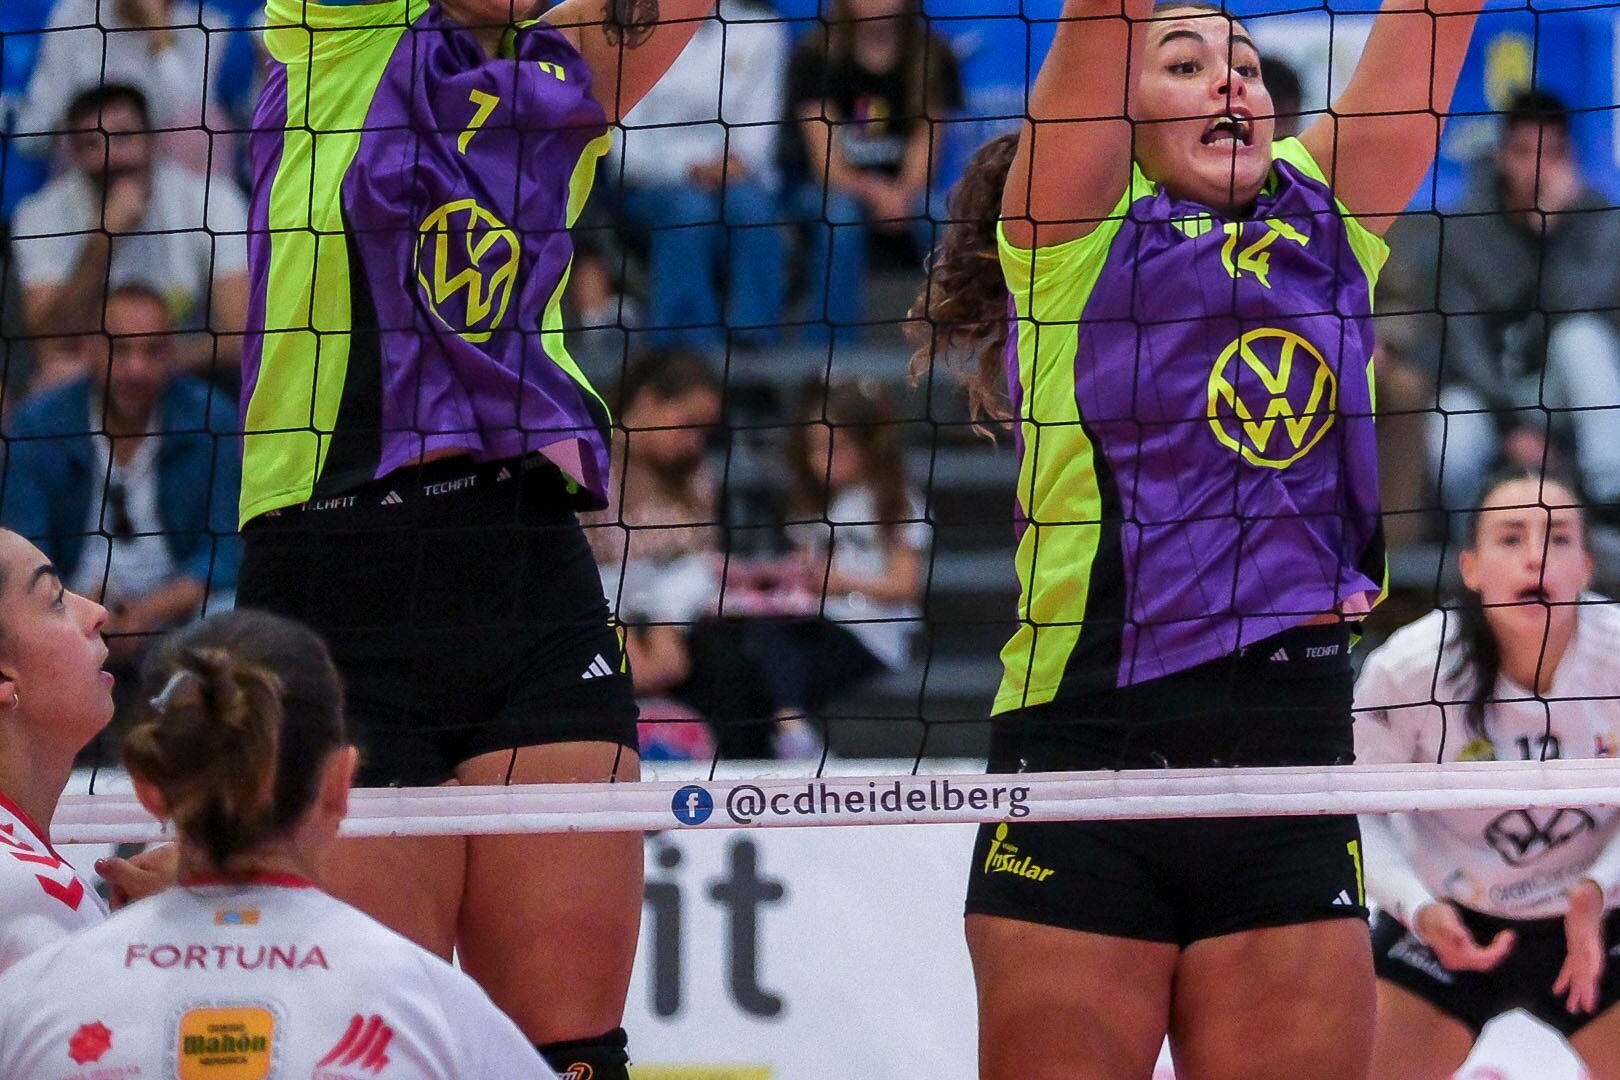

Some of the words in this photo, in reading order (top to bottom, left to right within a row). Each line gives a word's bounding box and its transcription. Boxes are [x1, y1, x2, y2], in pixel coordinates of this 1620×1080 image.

[424, 475, 478, 497] TECHFIT
[1305, 644, 1340, 659] TECHFIT
[726, 779, 1031, 825] @cdheidelberg
[643, 832, 788, 1019] it
[124, 943, 330, 970] FORTUNA
